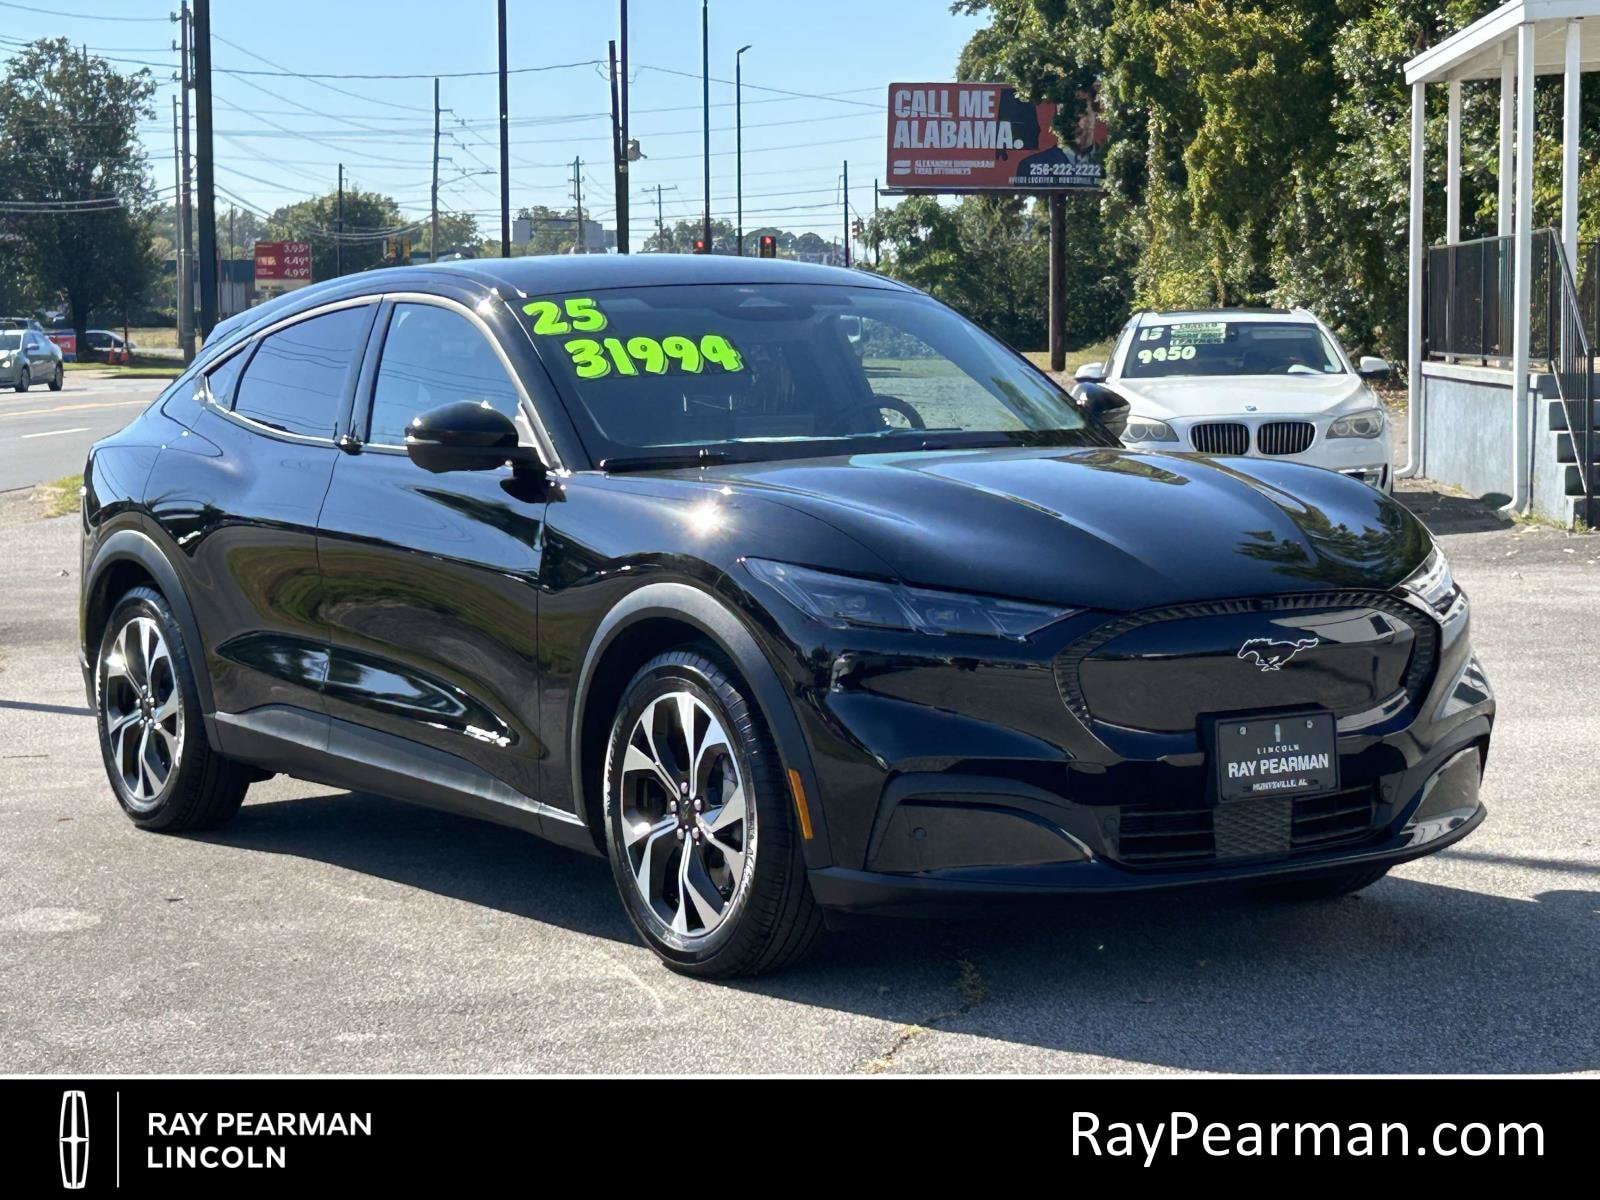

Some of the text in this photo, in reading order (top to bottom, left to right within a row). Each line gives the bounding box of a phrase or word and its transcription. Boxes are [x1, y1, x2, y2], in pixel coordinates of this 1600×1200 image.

[895, 89, 995, 118] CALL ME
[893, 120, 1024, 149] ALABAMA.
[1029, 163, 1101, 176] 256-222-2222
[522, 298, 608, 335] 25
[564, 335, 744, 379] 31994
[1137, 345, 1197, 364] 9450
[1256, 744, 1300, 755] LINCOLN
[1228, 753, 1329, 778] RAY PEARMAN
[1298, 778, 1308, 786] AL
